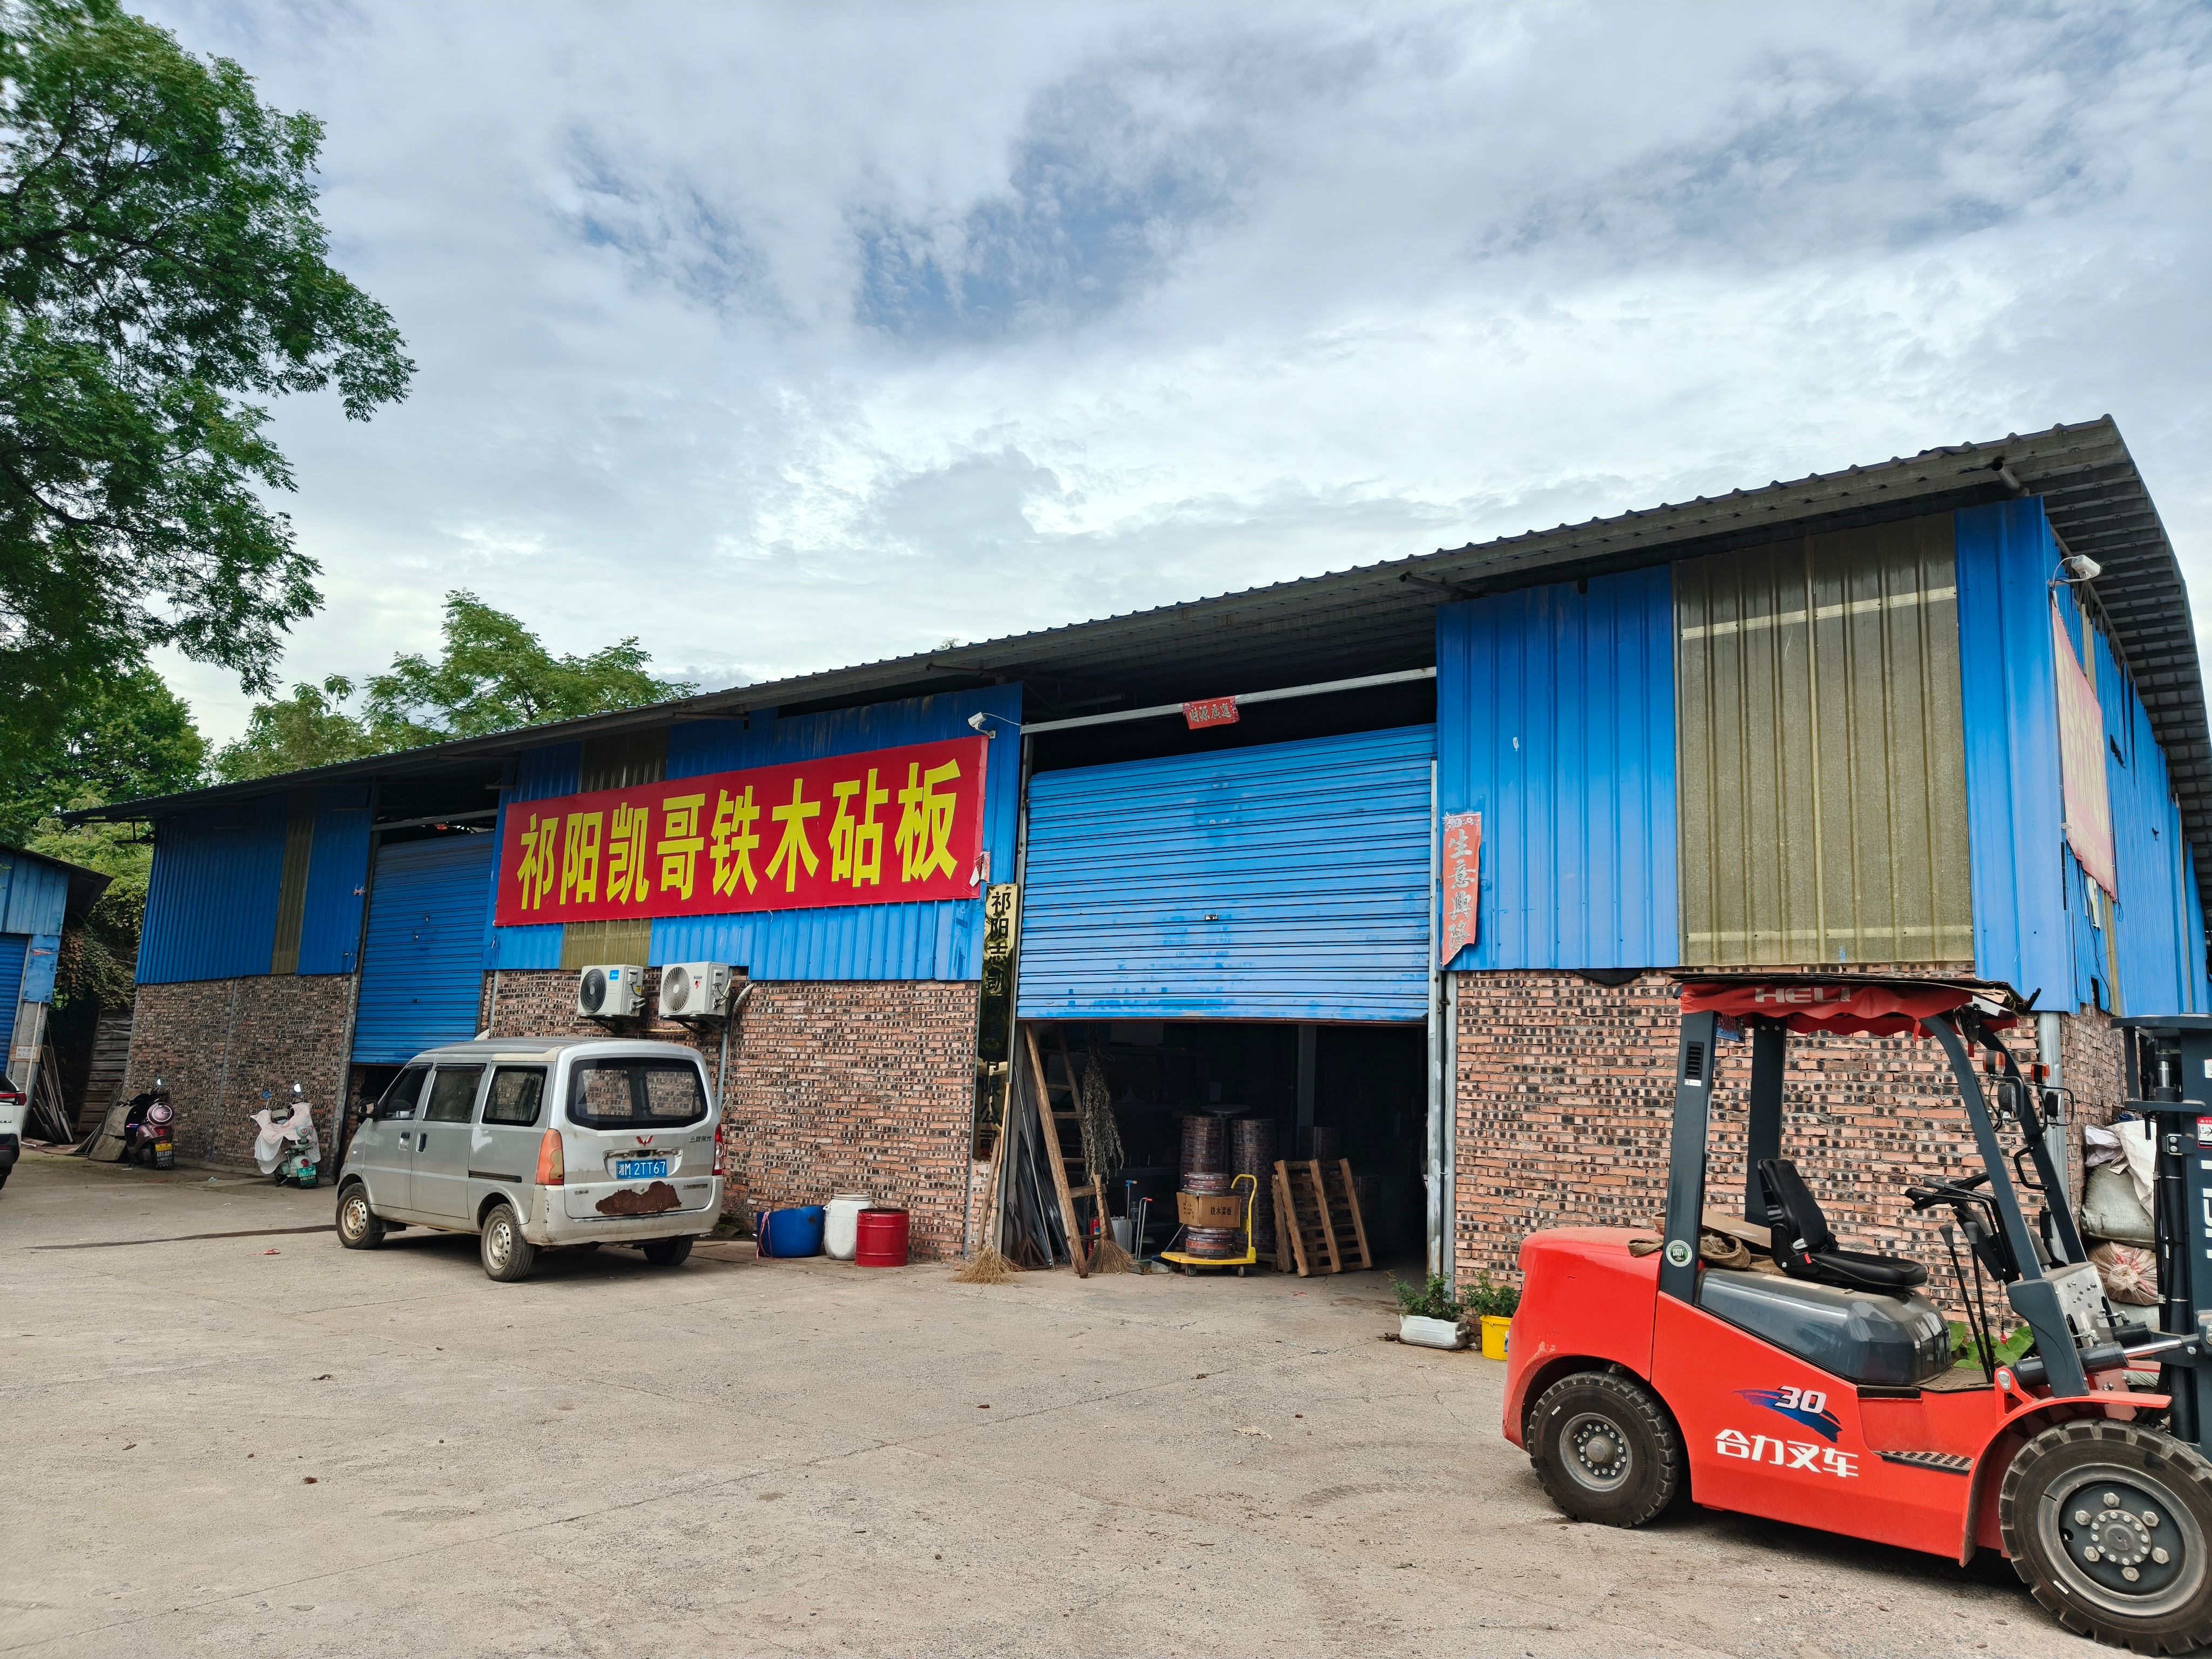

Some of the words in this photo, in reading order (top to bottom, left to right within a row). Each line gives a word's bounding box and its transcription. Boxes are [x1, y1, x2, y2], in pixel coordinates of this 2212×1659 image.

[516, 758, 961, 910] 祁阳凯哥铁木砧板
[1755, 987, 1851, 1003] HELI
[1775, 1385, 1827, 1413] 30
[1715, 1428, 1859, 1478] 合力叉车
